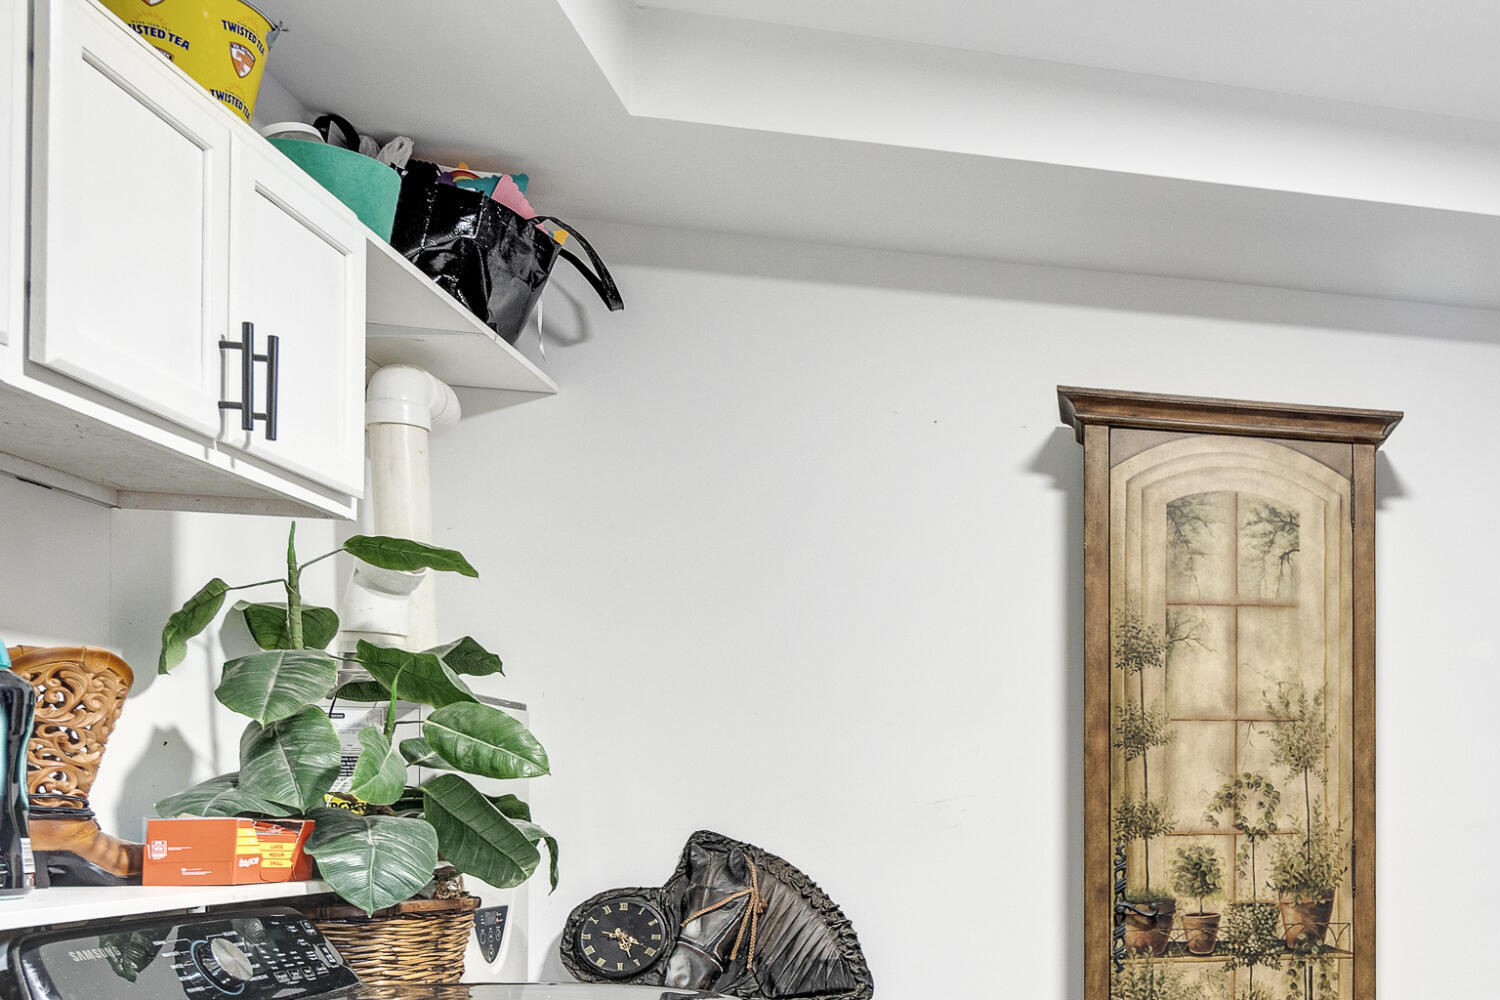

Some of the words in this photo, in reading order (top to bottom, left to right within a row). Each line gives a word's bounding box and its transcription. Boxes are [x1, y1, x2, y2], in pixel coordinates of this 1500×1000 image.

[127, 23, 166, 39] ISTED
[168, 32, 190, 50] TEA
[221, 19, 257, 45] TWISTED
[256, 37, 265, 57] TEA
[209, 88, 243, 111] TWISTED
[68, 946, 122, 962] SAMSUNG
